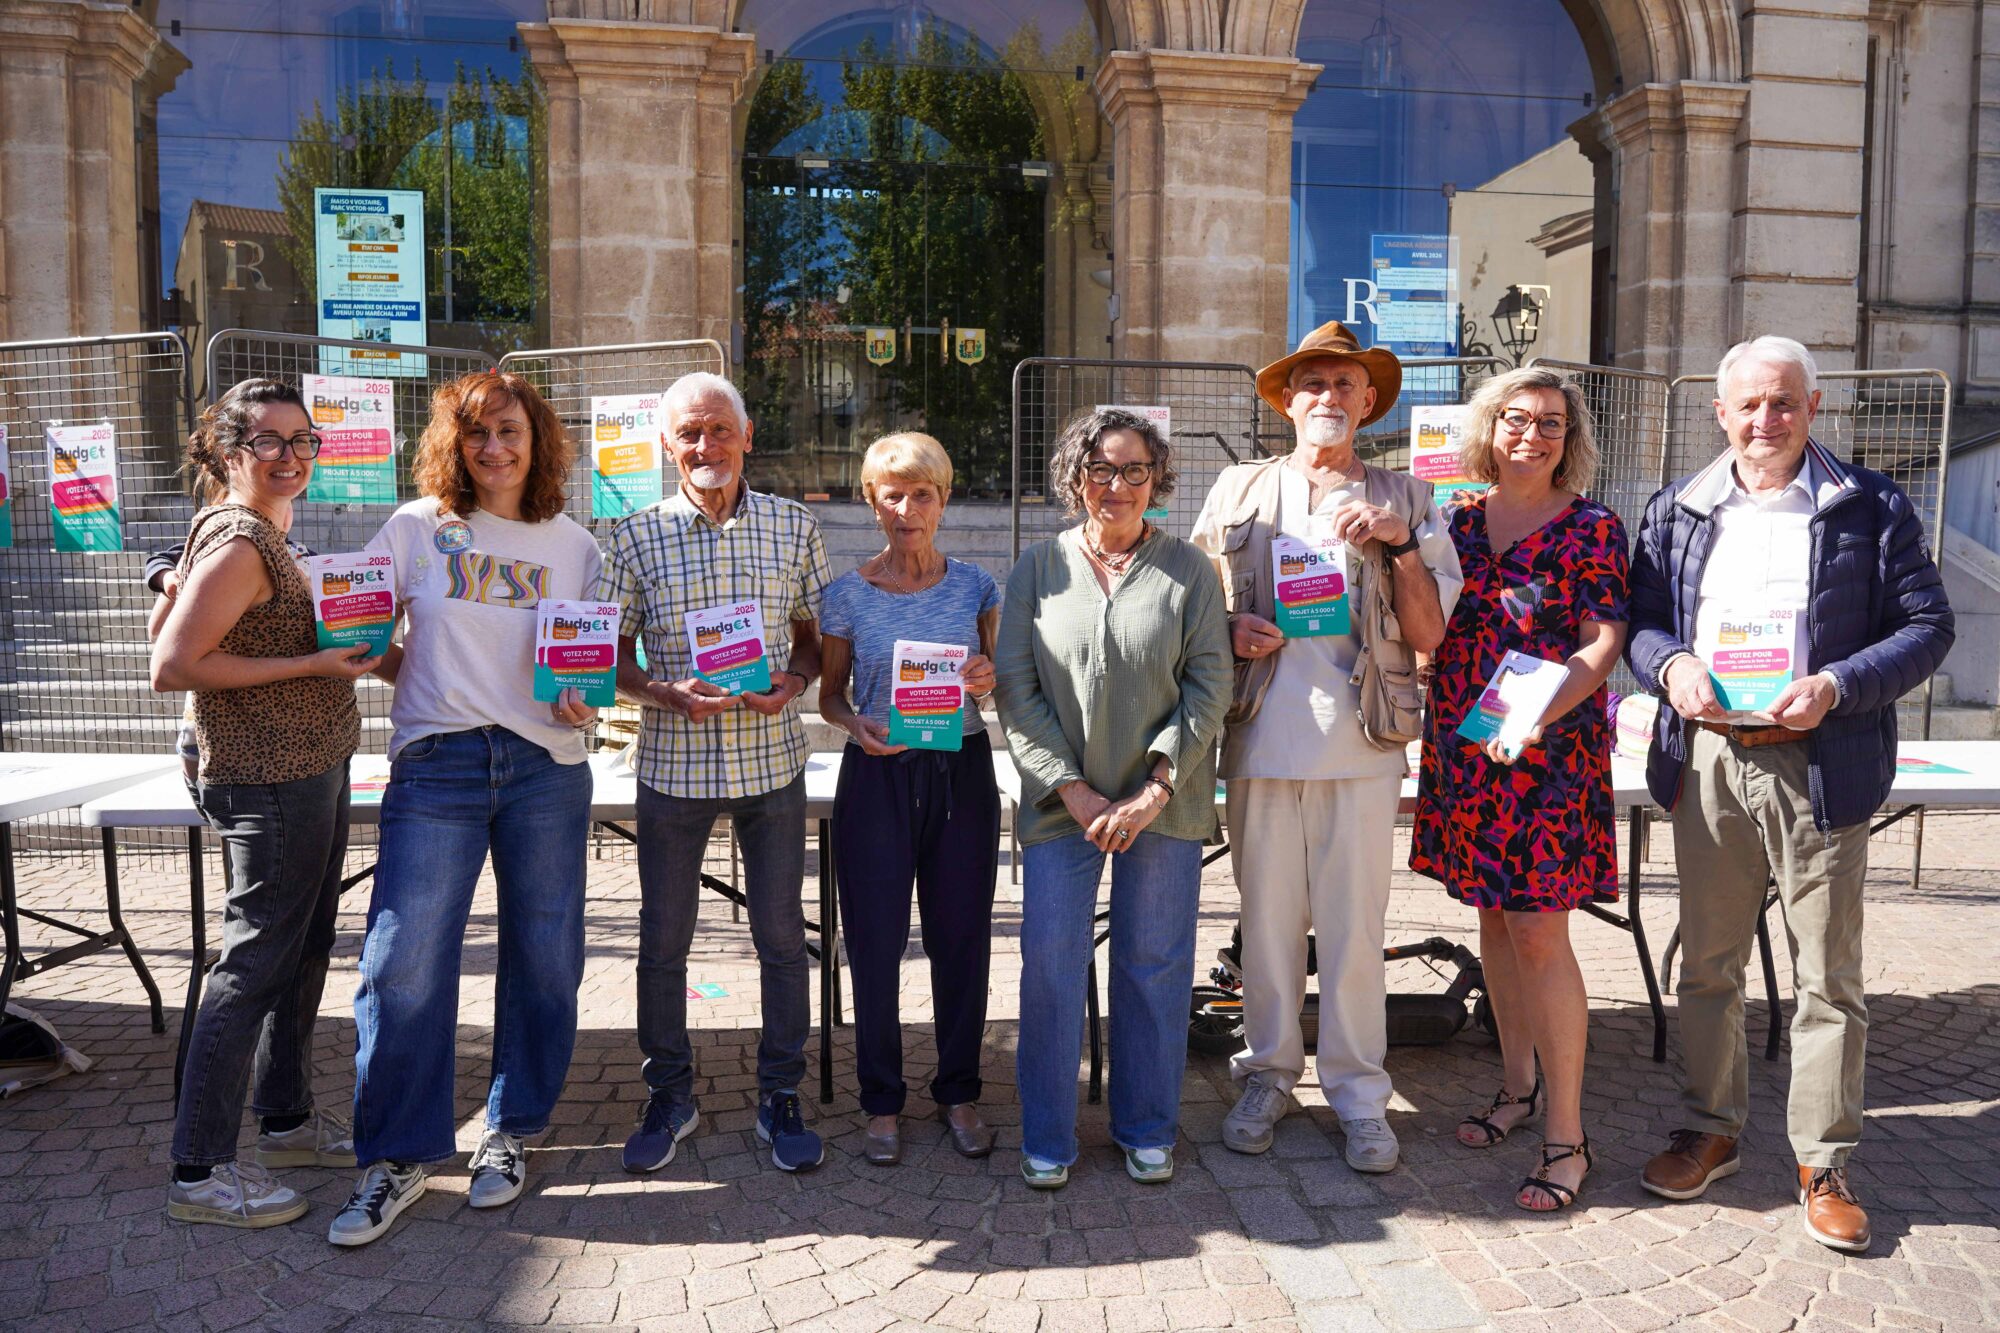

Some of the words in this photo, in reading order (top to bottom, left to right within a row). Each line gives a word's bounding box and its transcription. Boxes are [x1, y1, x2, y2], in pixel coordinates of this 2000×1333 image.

[219, 240, 272, 291] R
[1342, 278, 1384, 325] R
[1515, 284, 1550, 329] F
[366, 383, 390, 394] 2025
[639, 399, 658, 408] 2025
[1147, 410, 1168, 420] 2025
[93, 430, 111, 440] 2025
[1420, 423, 1461, 438] Budg
[614, 447, 636, 456] VOTEZ
[1429, 456, 1451, 464] VOTEZ
[66, 486, 84, 494] VOTEZ
[85, 483, 101, 492] POUR
[1322, 538, 1341, 547] 2025
[369, 557, 391, 565] 2025
[336, 598, 357, 606] VOTEZ
[597, 607, 617, 616] 2025
[735, 604, 755, 615] 2025
[1769, 610, 1792, 619] 2025
[711, 651, 730, 660] VOTEZ
[731, 646, 747, 655] POUR
[944, 649, 964, 657] 2025
[710, 673, 730, 682] PROJET
